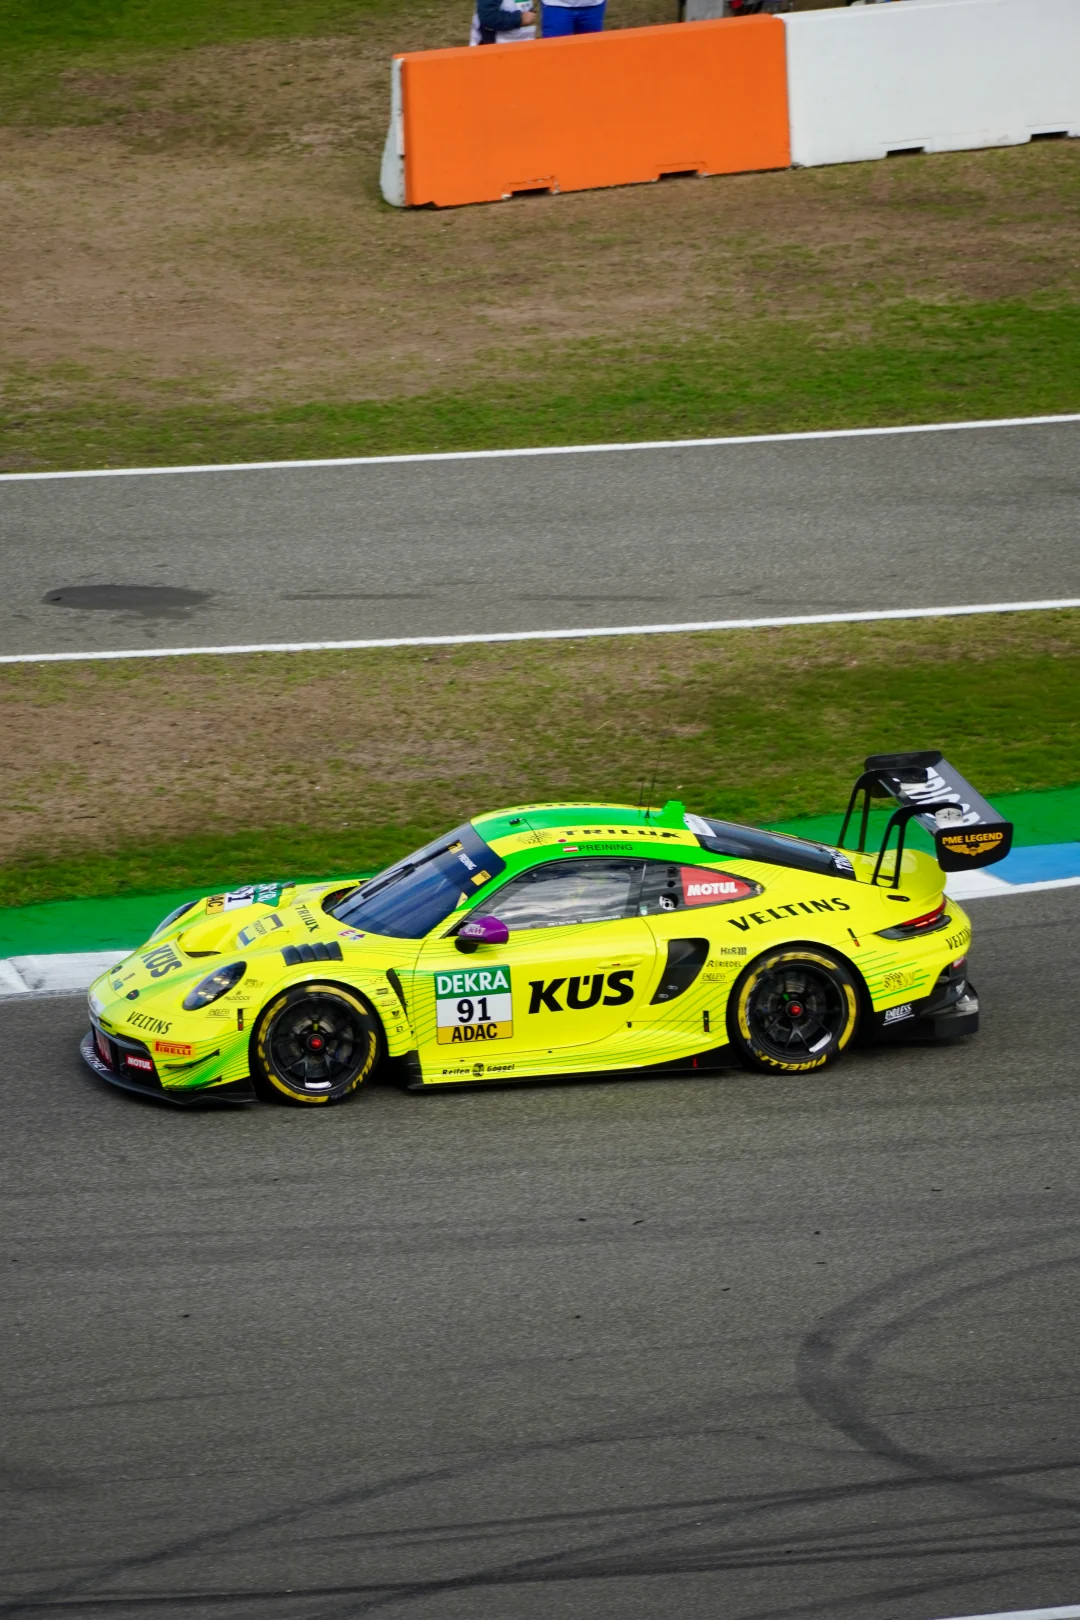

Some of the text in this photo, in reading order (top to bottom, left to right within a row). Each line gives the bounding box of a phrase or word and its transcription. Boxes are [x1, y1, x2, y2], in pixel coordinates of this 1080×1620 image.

[561, 829, 682, 840] TRILUX
[942, 831, 1004, 845] PME LEGEND
[578, 843, 633, 852] PREINING
[687, 881, 738, 897] MOTUL
[727, 897, 851, 932] VELTINS
[140, 944, 183, 978] KÜS
[436, 970, 509, 995] DEKRA
[528, 969, 635, 1015] KÜS
[456, 996, 491, 1024] 91
[884, 1002, 912, 1020] ENDLESS
[125, 1011, 173, 1035] VELTINS
[451, 1022, 498, 1043] ADAC
[155, 1041, 192, 1056] PIRELLI
[127, 1056, 152, 1070] MOTUL
[442, 1068, 470, 1076] Reifen
